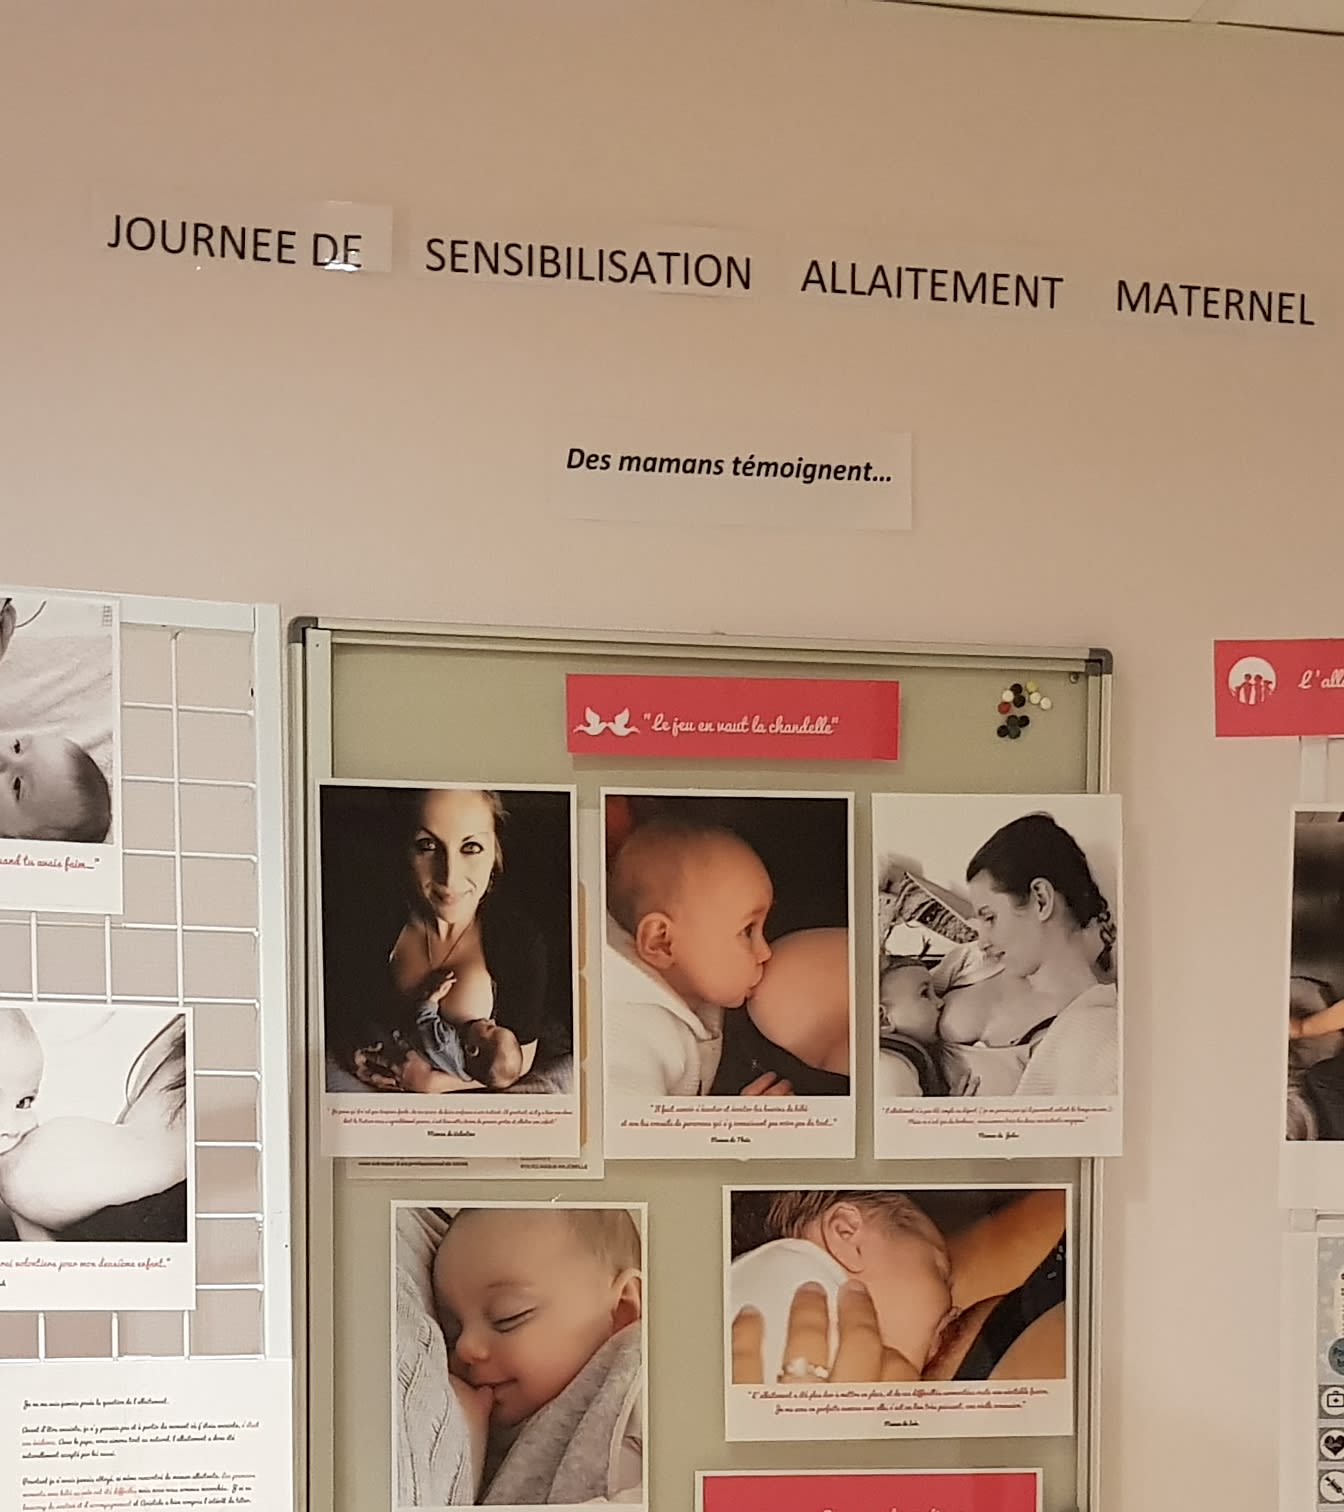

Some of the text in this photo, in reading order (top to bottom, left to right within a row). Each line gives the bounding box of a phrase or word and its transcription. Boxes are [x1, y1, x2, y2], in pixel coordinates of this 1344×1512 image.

[108, 215, 1314, 325] JOURNEE DE SENSIBILISATION ALLAITEMENT MATERNEL
[567, 448, 891, 484] Des mamans témoignent...
[672, 718, 695, 736] jeu
[698, 722, 715, 731] en
[717, 716, 749, 732] vaut
[752, 715, 766, 733] la
